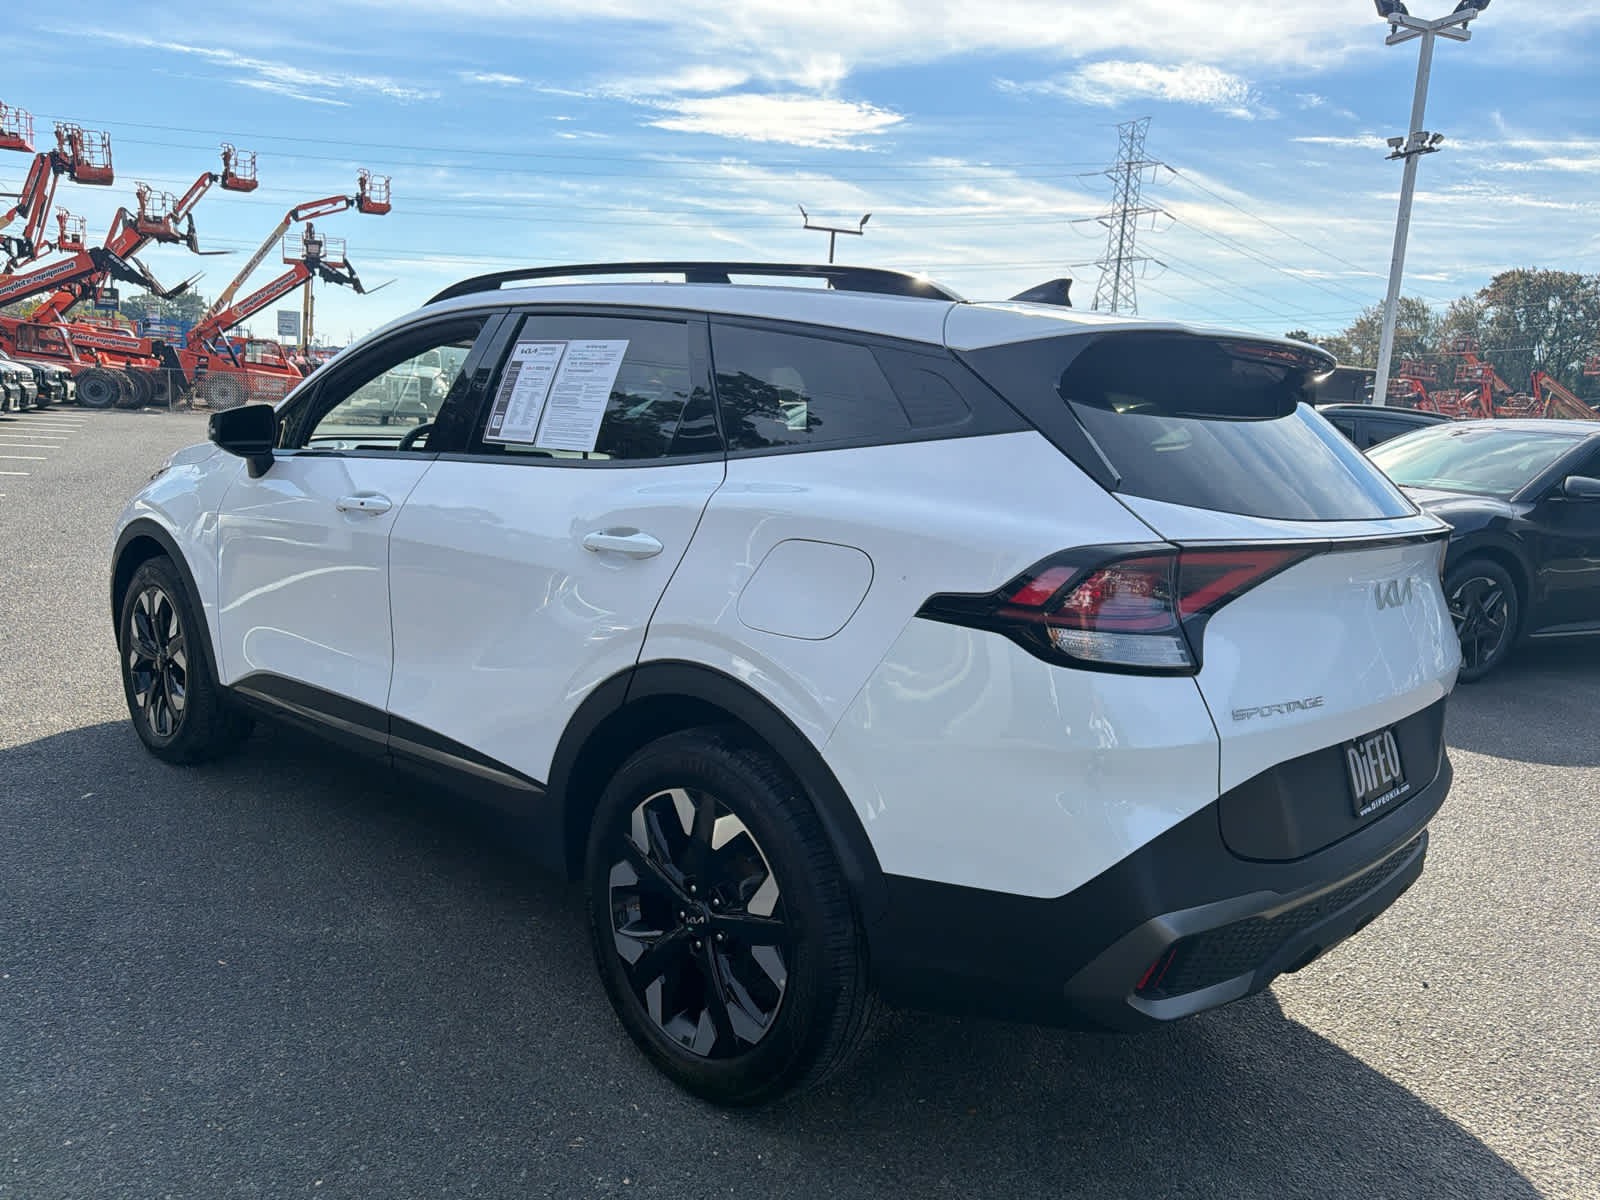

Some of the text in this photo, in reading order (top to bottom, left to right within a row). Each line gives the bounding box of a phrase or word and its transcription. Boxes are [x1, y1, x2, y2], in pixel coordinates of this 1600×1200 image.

[0, 261, 76, 294] omplete equipment
[1375, 577, 1413, 610] KIA
[1232, 696, 1325, 720] SPORTAGE
[685, 916, 705, 925] KIA
